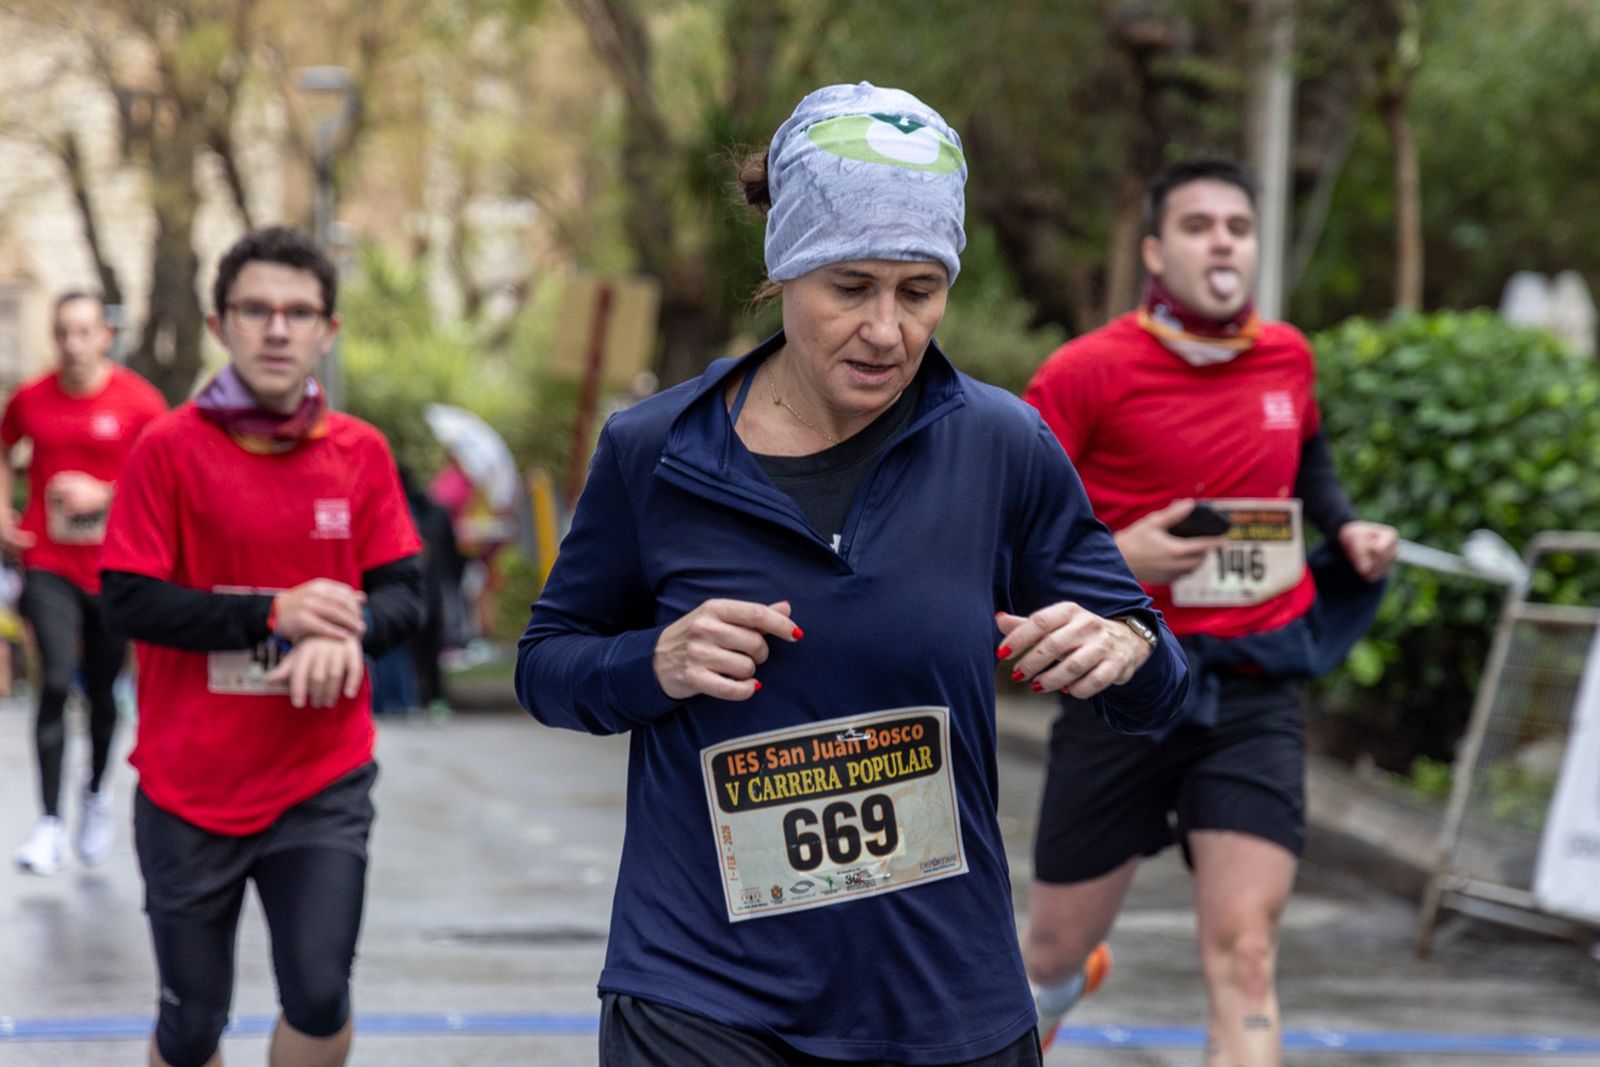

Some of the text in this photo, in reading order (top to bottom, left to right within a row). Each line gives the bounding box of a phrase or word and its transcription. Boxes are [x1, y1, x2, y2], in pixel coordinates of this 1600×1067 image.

[1214, 547, 1266, 583] 146
[725, 745, 934, 807] V CARRERA POPULAR
[727, 723, 925, 777] IES San Juan Bosco
[782, 793, 900, 872] 669
